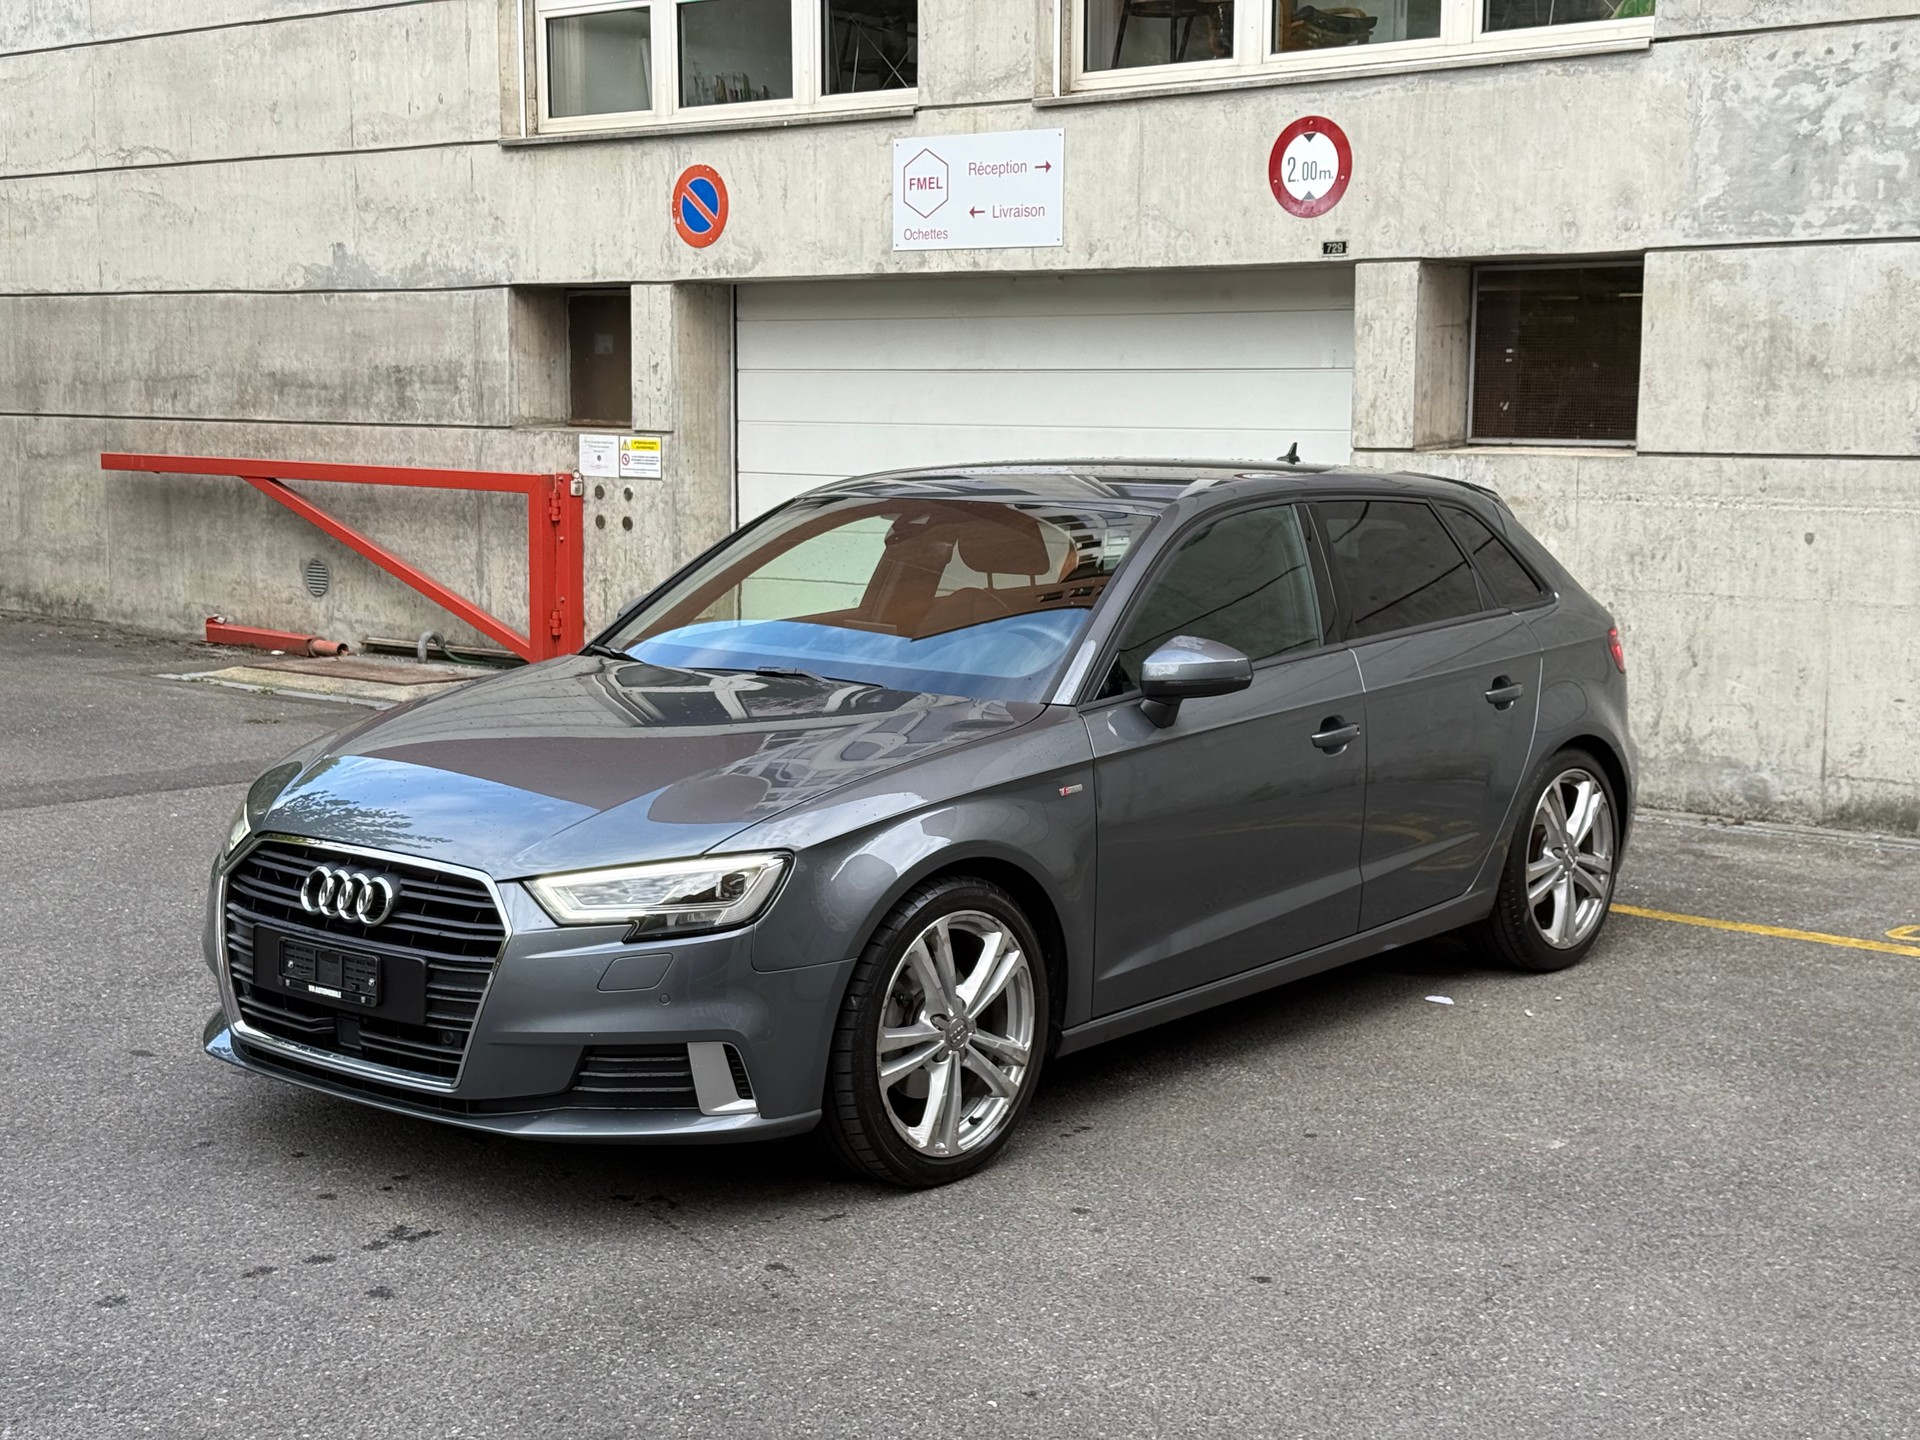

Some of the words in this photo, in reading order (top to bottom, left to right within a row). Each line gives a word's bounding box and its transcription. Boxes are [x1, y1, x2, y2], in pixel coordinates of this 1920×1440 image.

[968, 160, 1028, 178] Réception
[909, 176, 943, 190] FMEL
[992, 204, 1046, 219] Livraison
[903, 228, 949, 241] Ochettes
[1326, 242, 1344, 254] 729
